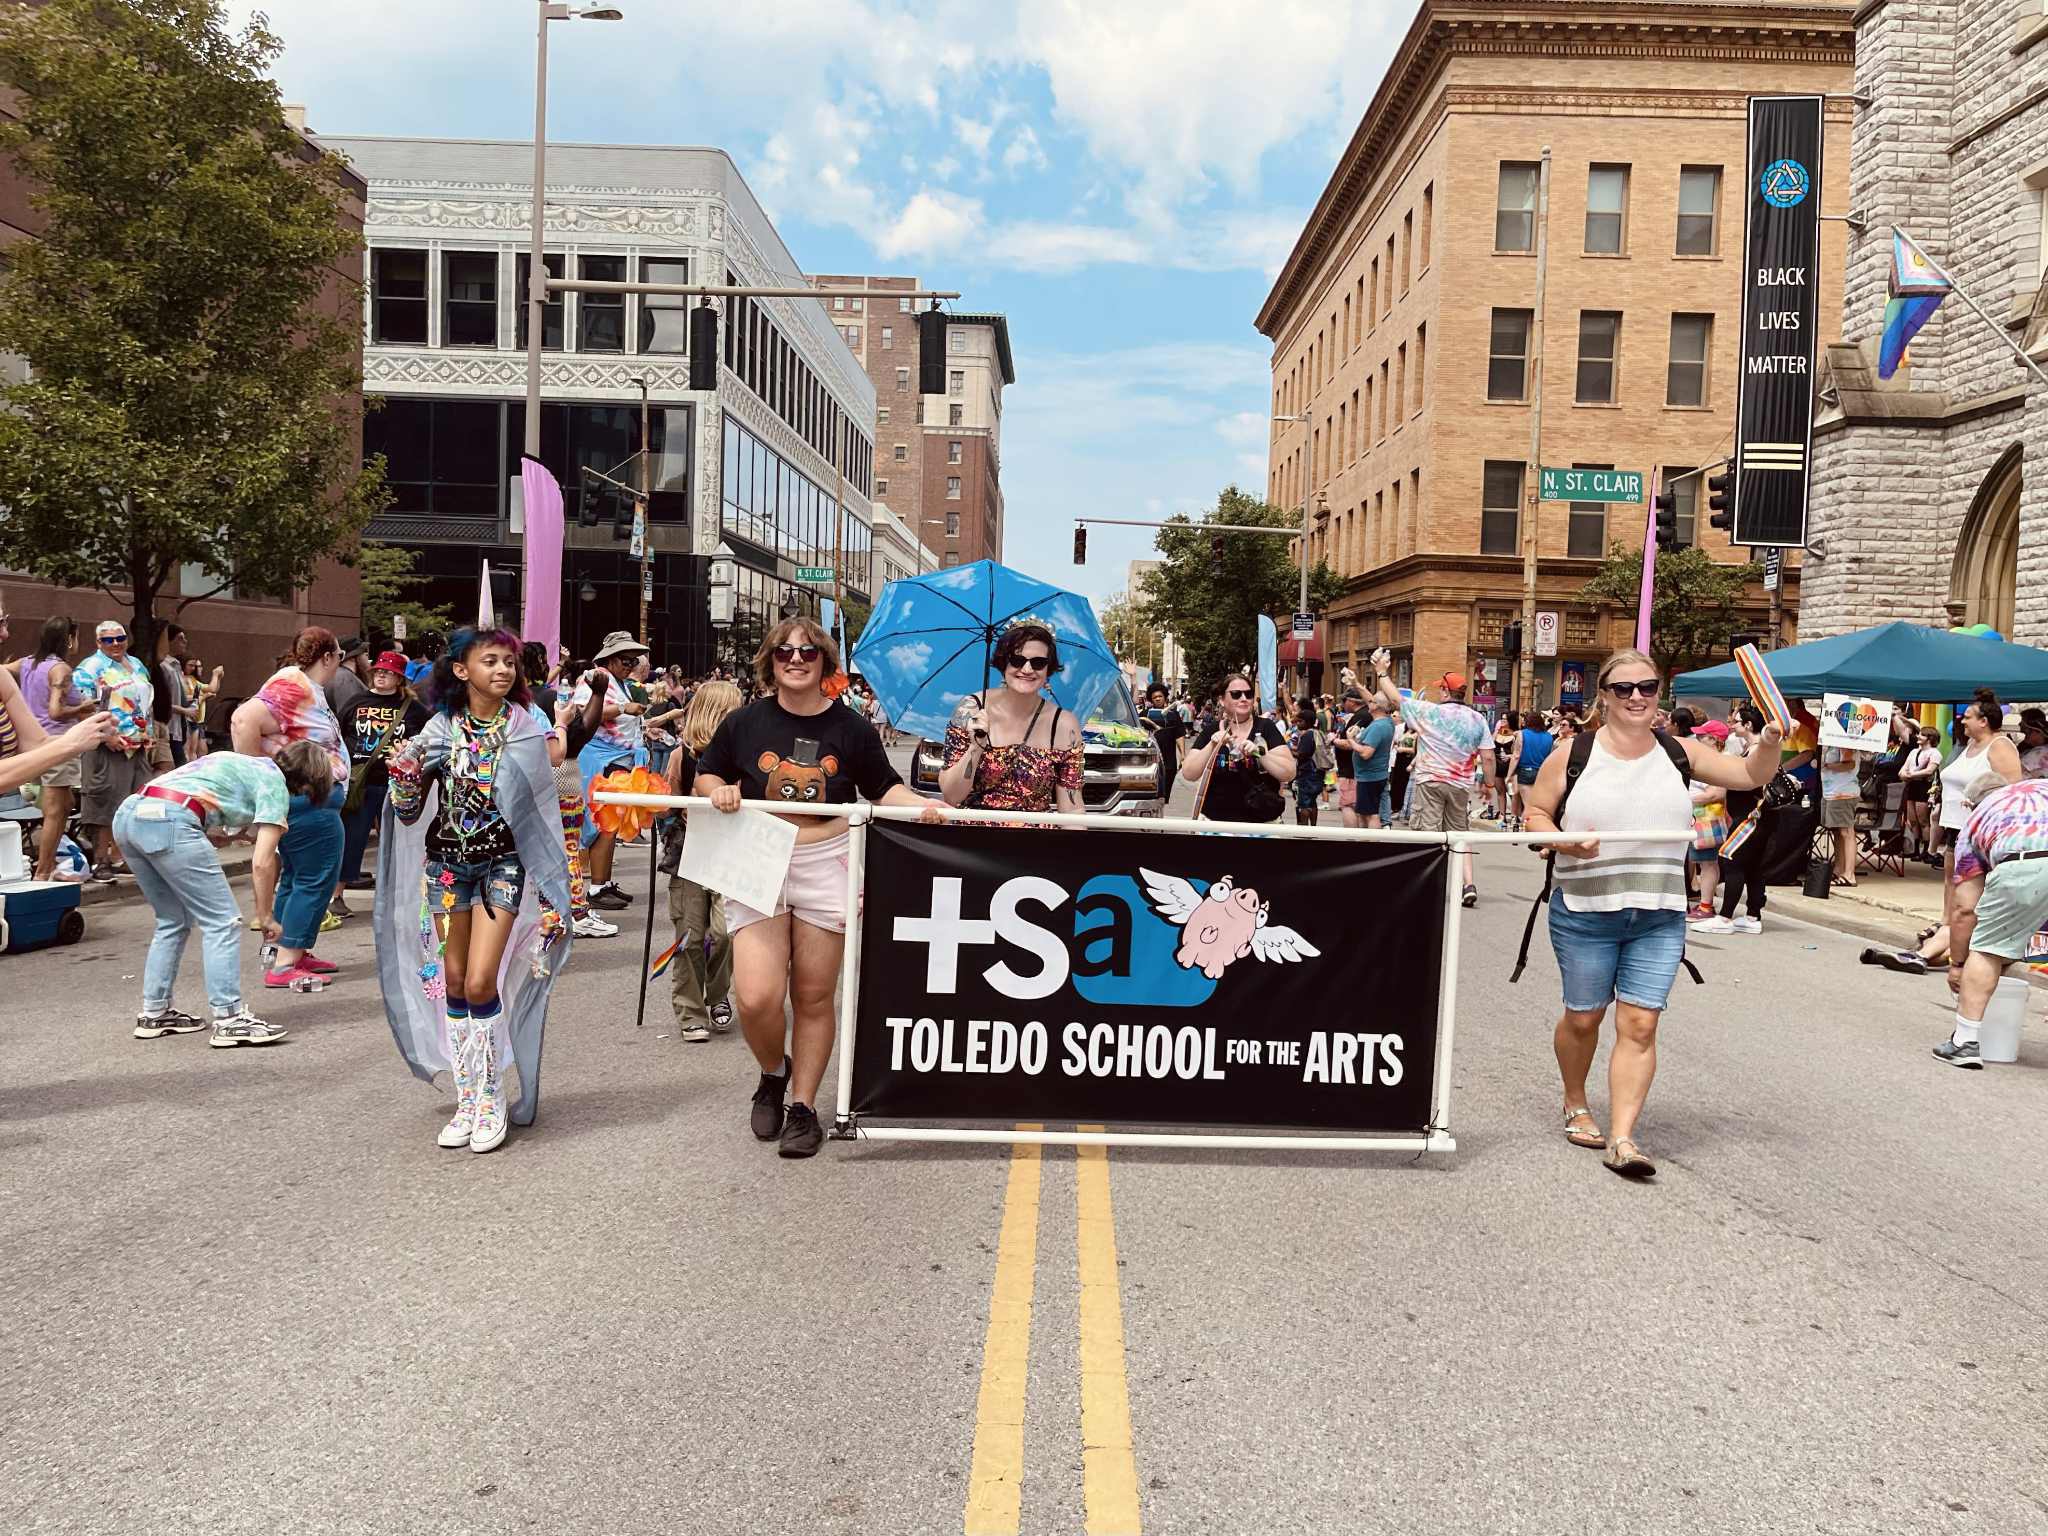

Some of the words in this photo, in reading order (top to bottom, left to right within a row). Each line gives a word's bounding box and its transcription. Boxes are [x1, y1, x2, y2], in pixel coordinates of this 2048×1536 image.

[1757, 267, 1806, 287] BLACK
[1759, 311, 1800, 330] LIVES
[1748, 356, 1807, 374] MATTER
[1544, 471, 1559, 490] N.
[1565, 472, 1588, 491] ST.
[1593, 474, 1639, 493] CLAIR
[1543, 491, 1558, 499] 400
[1625, 493, 1639, 502] 499
[797, 569, 804, 577] N.
[804, 569, 815, 578] ST.
[815, 569, 834, 578] CLAIR
[1853, 713, 1888, 725] TOGETHER
[886, 1017, 1049, 1075] TOLEDO
[1061, 1022, 1226, 1080] SCHOOL
[1226, 1038, 1262, 1065] FOR
[1265, 1040, 1300, 1066] THE
[1302, 1031, 1405, 1087] ARTS
